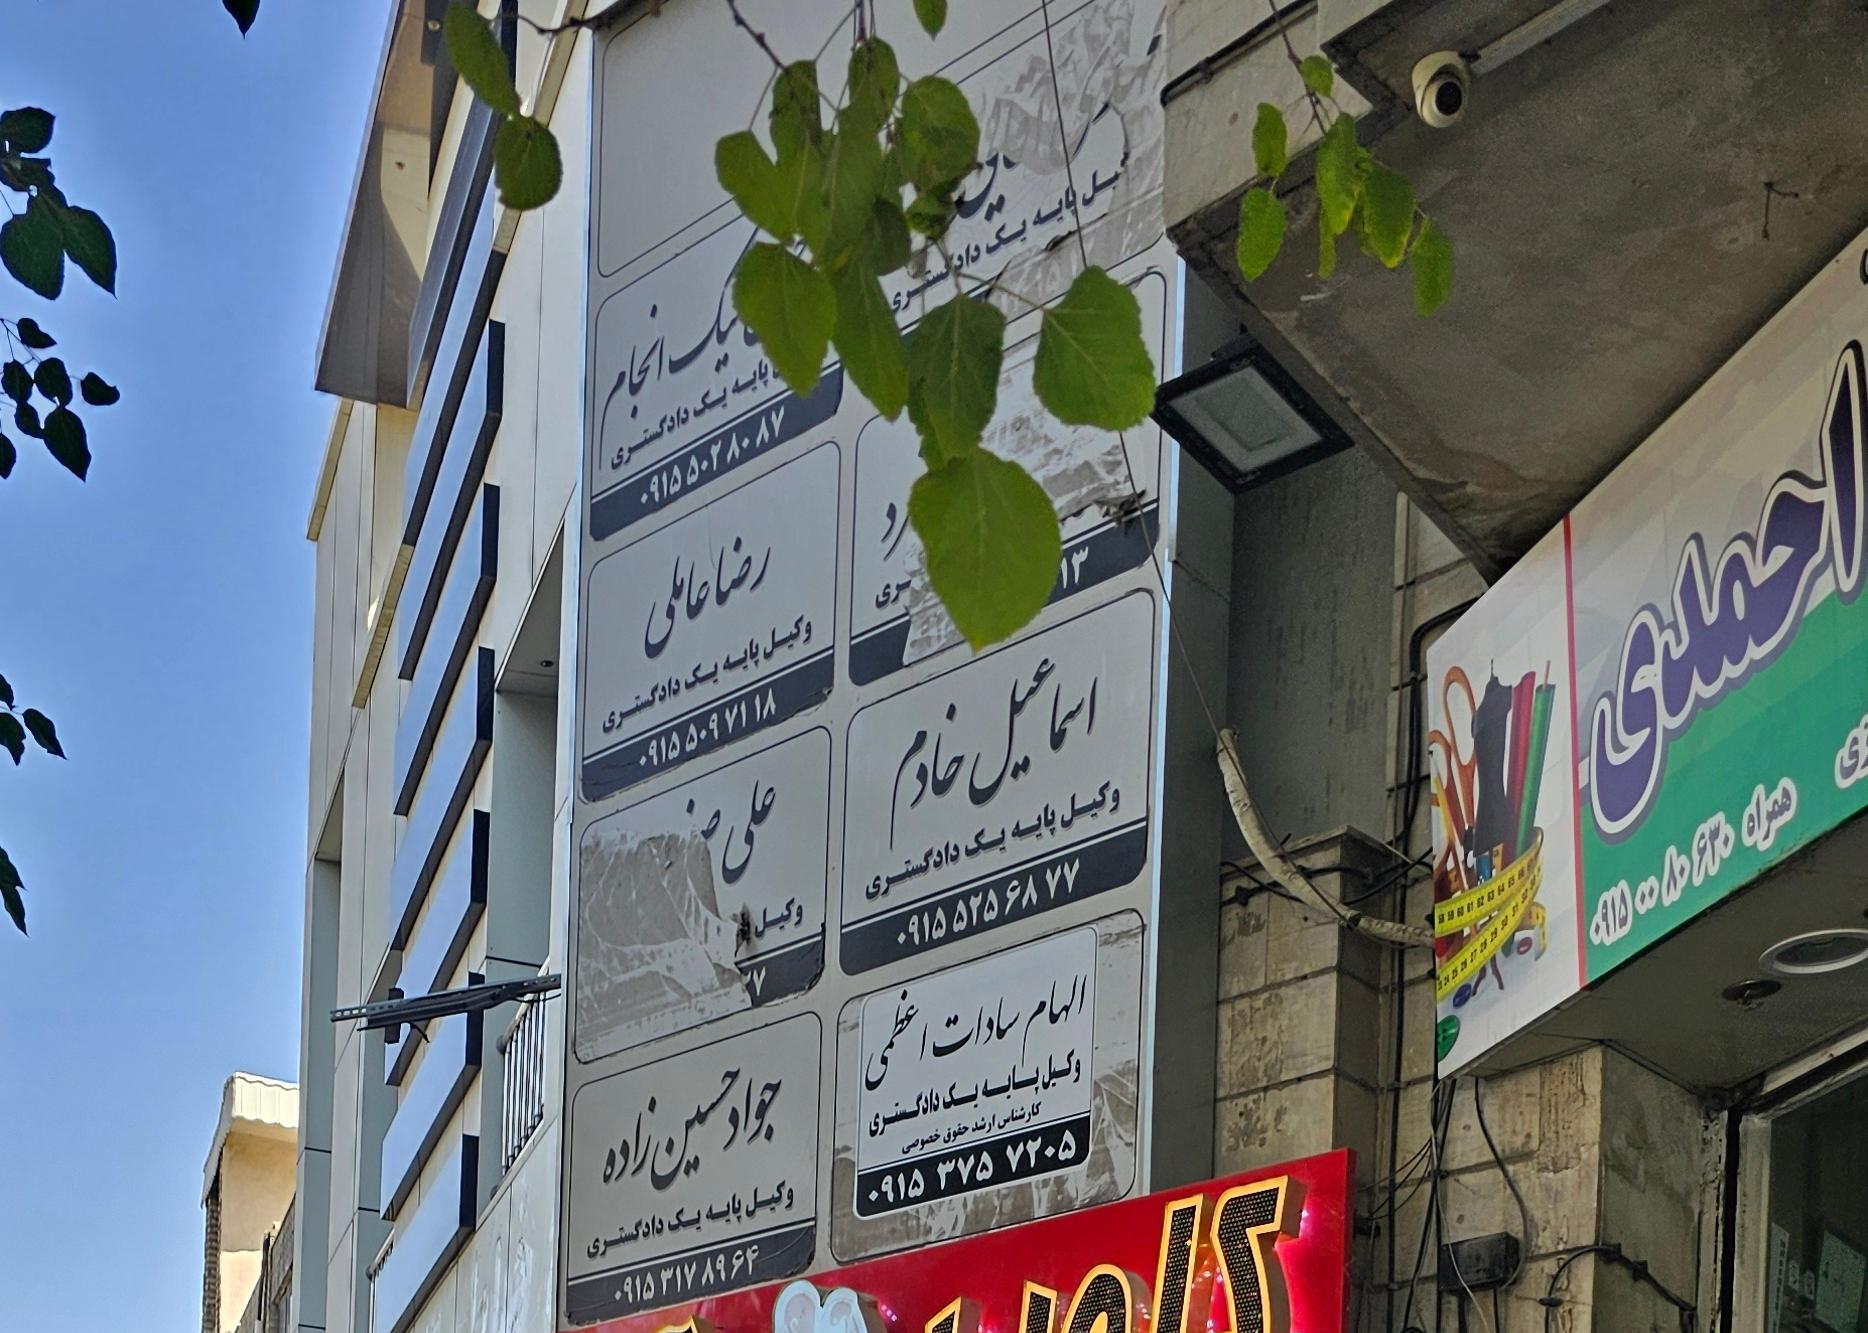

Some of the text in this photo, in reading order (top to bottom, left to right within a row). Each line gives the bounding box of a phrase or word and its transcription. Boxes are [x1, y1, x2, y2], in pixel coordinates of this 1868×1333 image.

[986, 219, 1026, 254] یک
[611, 406, 689, 471] دادگستری
[693, 387, 728, 418] یک
[640, 464, 682, 504] ۰۹۱۵
[726, 432, 751, 465] ۸۰
[755, 405, 786, 447] ۸۷
[715, 535, 771, 606] رضا
[1591, 350, 1865, 832] احمدی
[602, 613, 813, 734] وکیل پایه یک دادگستری
[639, 687, 777, 767] ۰۹۱۵ ۵۰۹ ۷۱ ۱۸
[889, 656, 1099, 852] اسماعیل خادم
[722, 779, 777, 885] علی
[865, 780, 1121, 902] وکیل پایه یک دادگستری
[1744, 780, 1796, 848] همراه
[897, 857, 1081, 947] ۰۹۱۵ ۵۲۵ ۶۸ ۷۷
[1592, 884, 1631, 943] ۰۹۱۵
[1663, 848, 1688, 903] ۸۰
[754, 896, 803, 939] وکیل
[931, 995, 1021, 1059] سادات
[1020, 973, 1088, 1069] الهام
[722, 1076, 783, 1152] جواد
[868, 1048, 1082, 1138] وکیل پایه یک دادگستری
[901, 1100, 1042, 1156] کارشناس ارشد حقوق خصوصی
[868, 1128, 1078, 1204] ۰۹۱۵ ۳۷۵ ۷۲۰۵
[586, 1179, 794, 1260] وکیل پایه یک دادگستری
[614, 1243, 761, 1305] ۰۹۱۵ ۳۱۷ ۸۹ ۶۴
